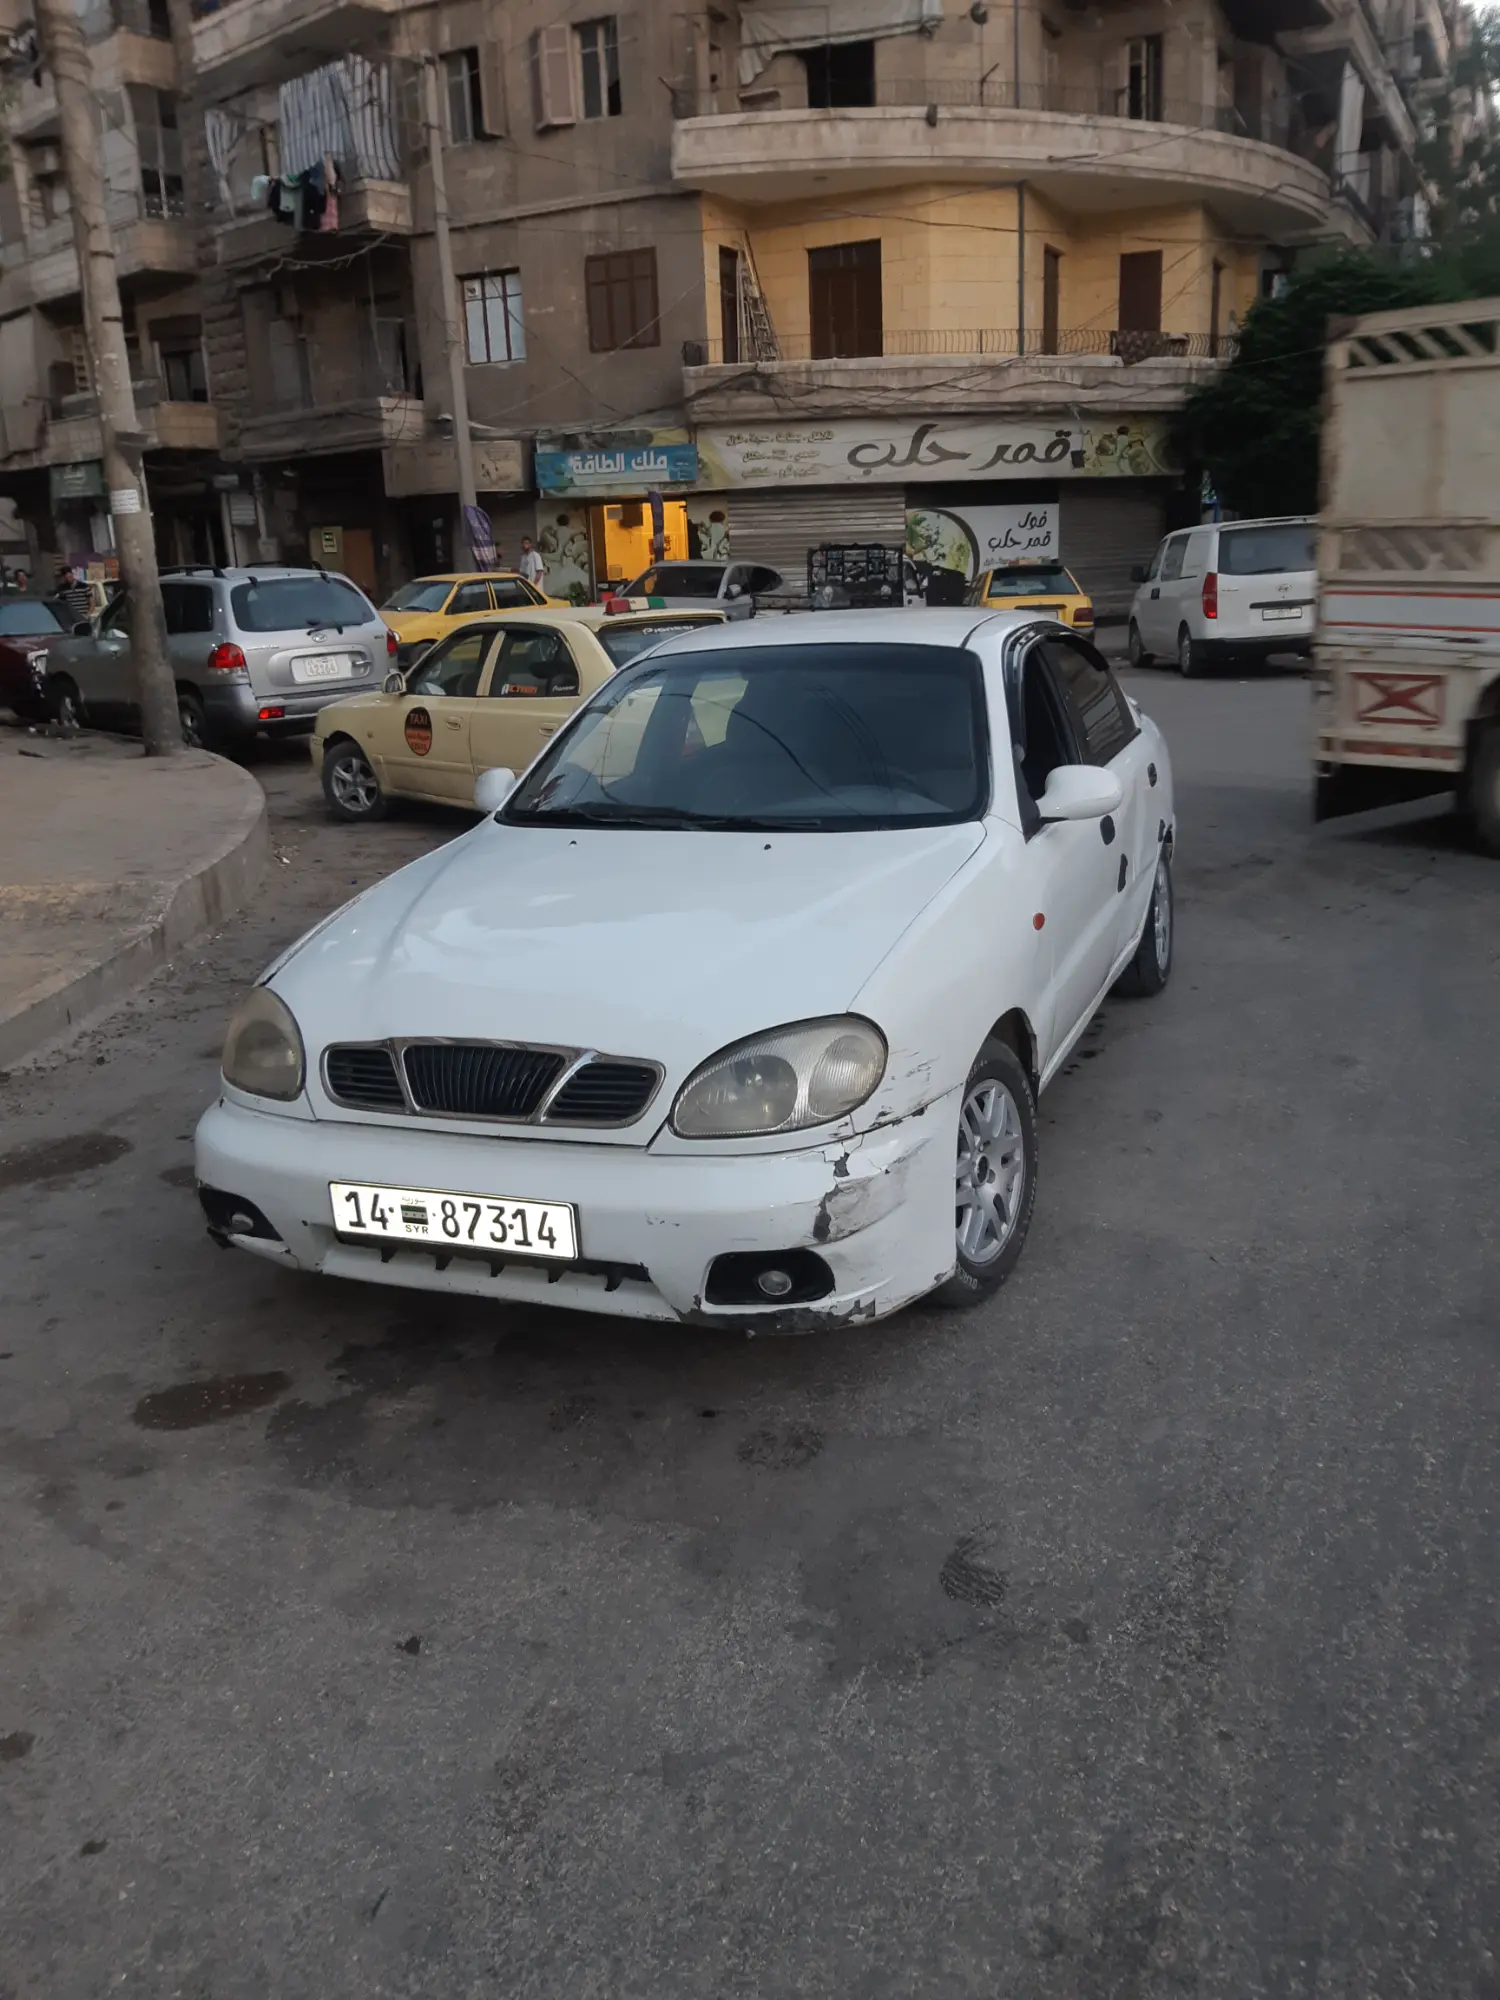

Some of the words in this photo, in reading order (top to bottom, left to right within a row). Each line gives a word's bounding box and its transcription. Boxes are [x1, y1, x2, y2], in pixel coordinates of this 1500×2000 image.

[847, 423, 972, 475] حلب
[968, 430, 1072, 471] قمر
[572, 452, 625, 475] الطاقة
[631, 450, 668, 471] ملك
[1018, 510, 1047, 530] فول
[988, 528, 1022, 552] حلب
[1021, 530, 1052, 550] قمر
[410, 713, 428, 725] TAXI
[345, 1191, 389, 1231] 14
[440, 1199, 558, 1250] 87314
[405, 1224, 429, 1234] SYR
